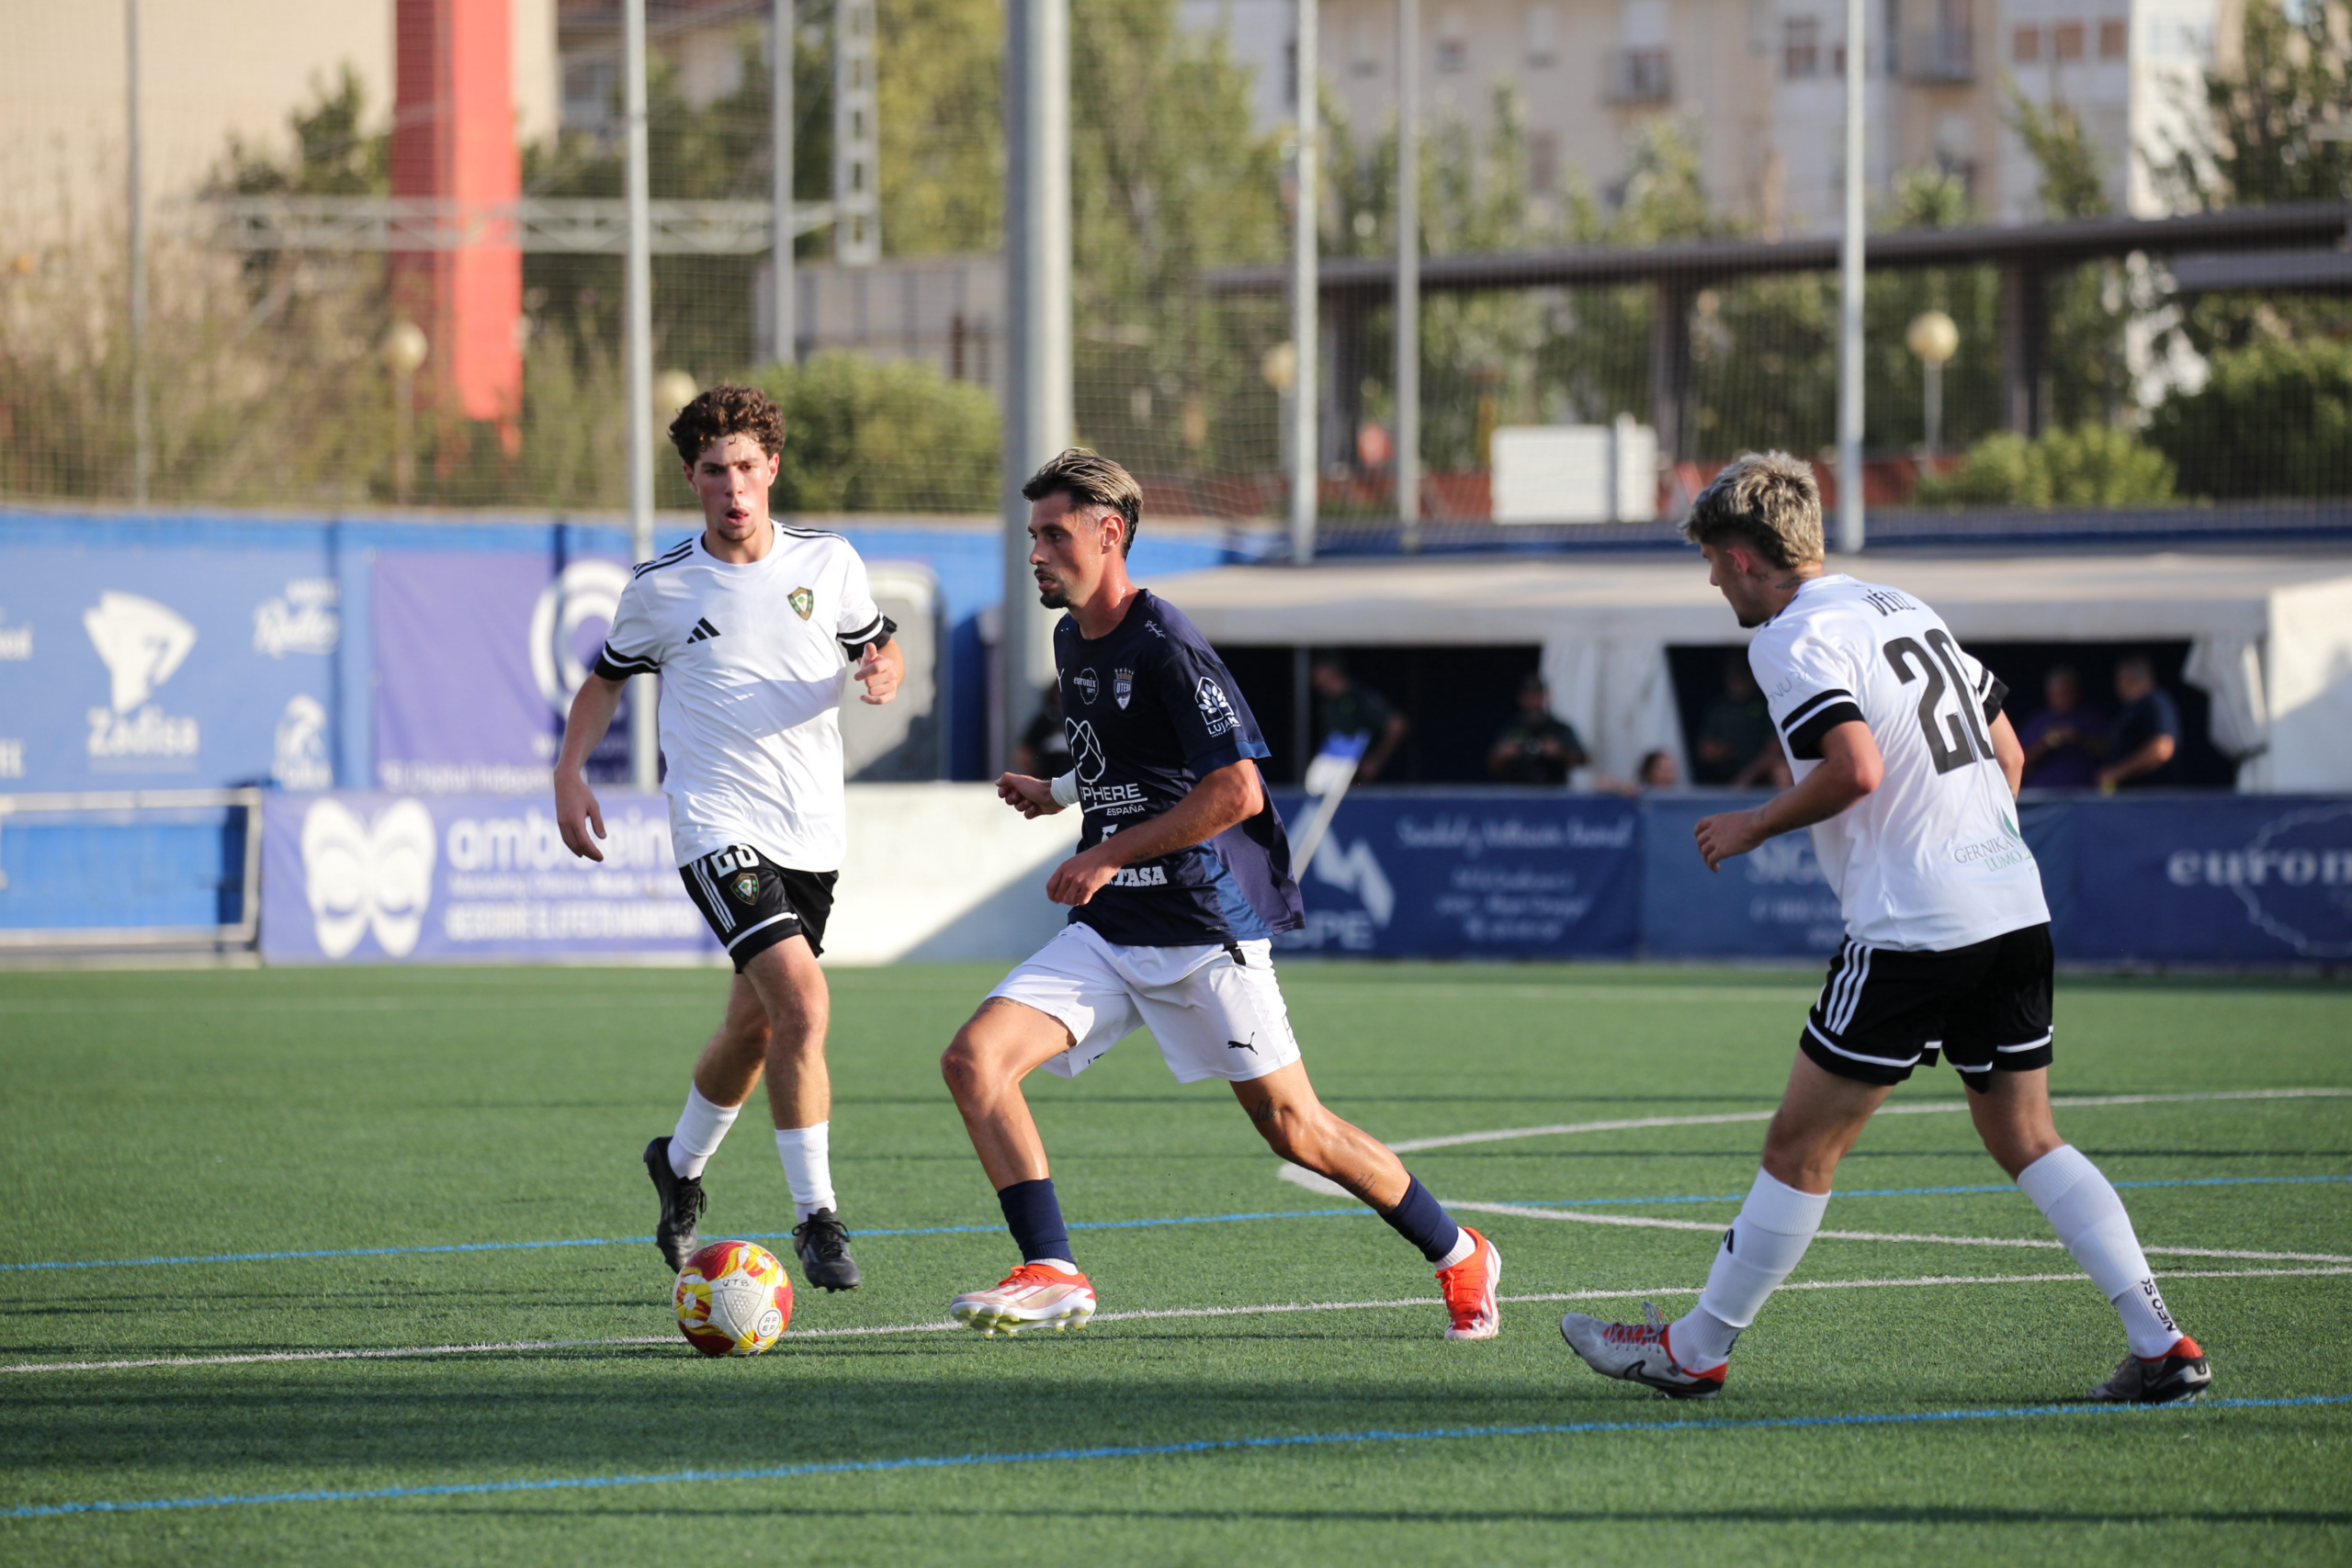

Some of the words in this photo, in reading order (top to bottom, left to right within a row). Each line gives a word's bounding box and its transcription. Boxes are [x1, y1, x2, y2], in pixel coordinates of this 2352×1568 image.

[1883, 628, 1996, 776] 20
[1106, 804, 1146, 817] ESPAÑA
[1954, 837, 2015, 863] GERNIKA
[1106, 865, 1168, 886] TASA
